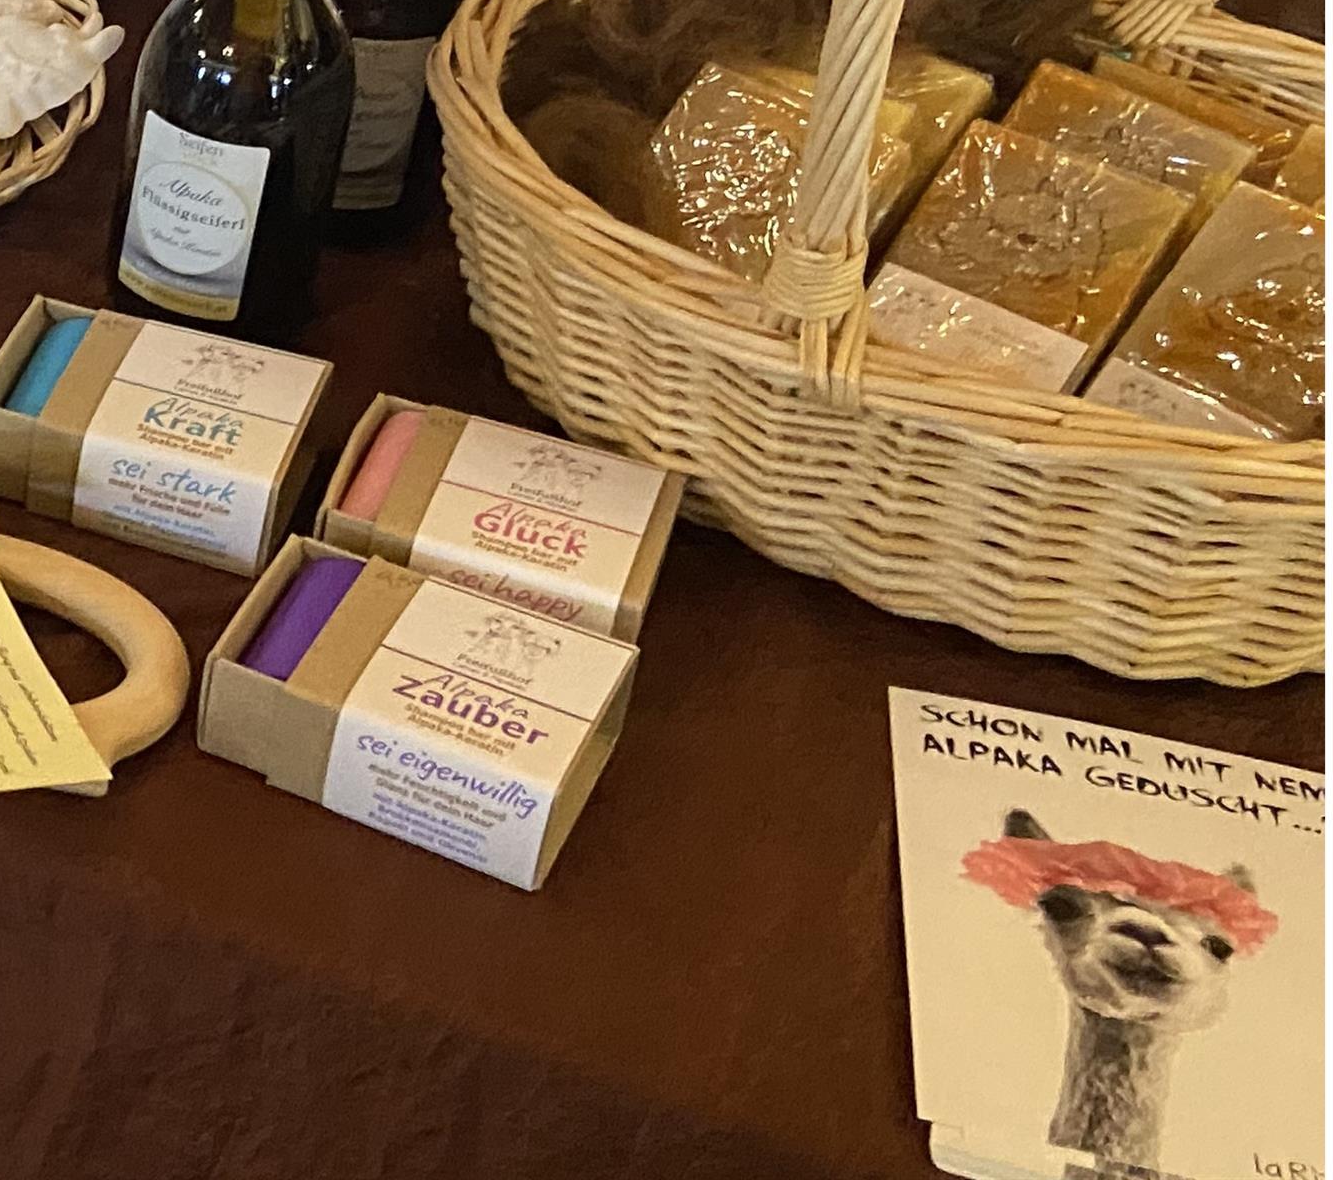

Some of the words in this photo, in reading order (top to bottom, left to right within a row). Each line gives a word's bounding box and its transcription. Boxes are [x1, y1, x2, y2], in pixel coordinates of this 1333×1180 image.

[159, 178, 223, 208] Alpaka
[144, 407, 242, 446] Kraft
[150, 396, 244, 429] Alpaka
[112, 458, 151, 479] sei
[156, 468, 237, 505] stark
[485, 502, 588, 539] Alpaka
[493, 572, 583, 621] happy
[392, 674, 550, 745] Zauber
[423, 673, 530, 720] Alpaka
[920, 702, 1044, 743] SCHON
[1065, 729, 1145, 765] MAL
[1163, 751, 1232, 783] MIT
[356, 733, 399, 760] sei
[399, 749, 539, 820] eigenwillig
[922, 732, 1064, 777] ALPAKA
[1084, 765, 1325, 836] GEDUSCHT...
